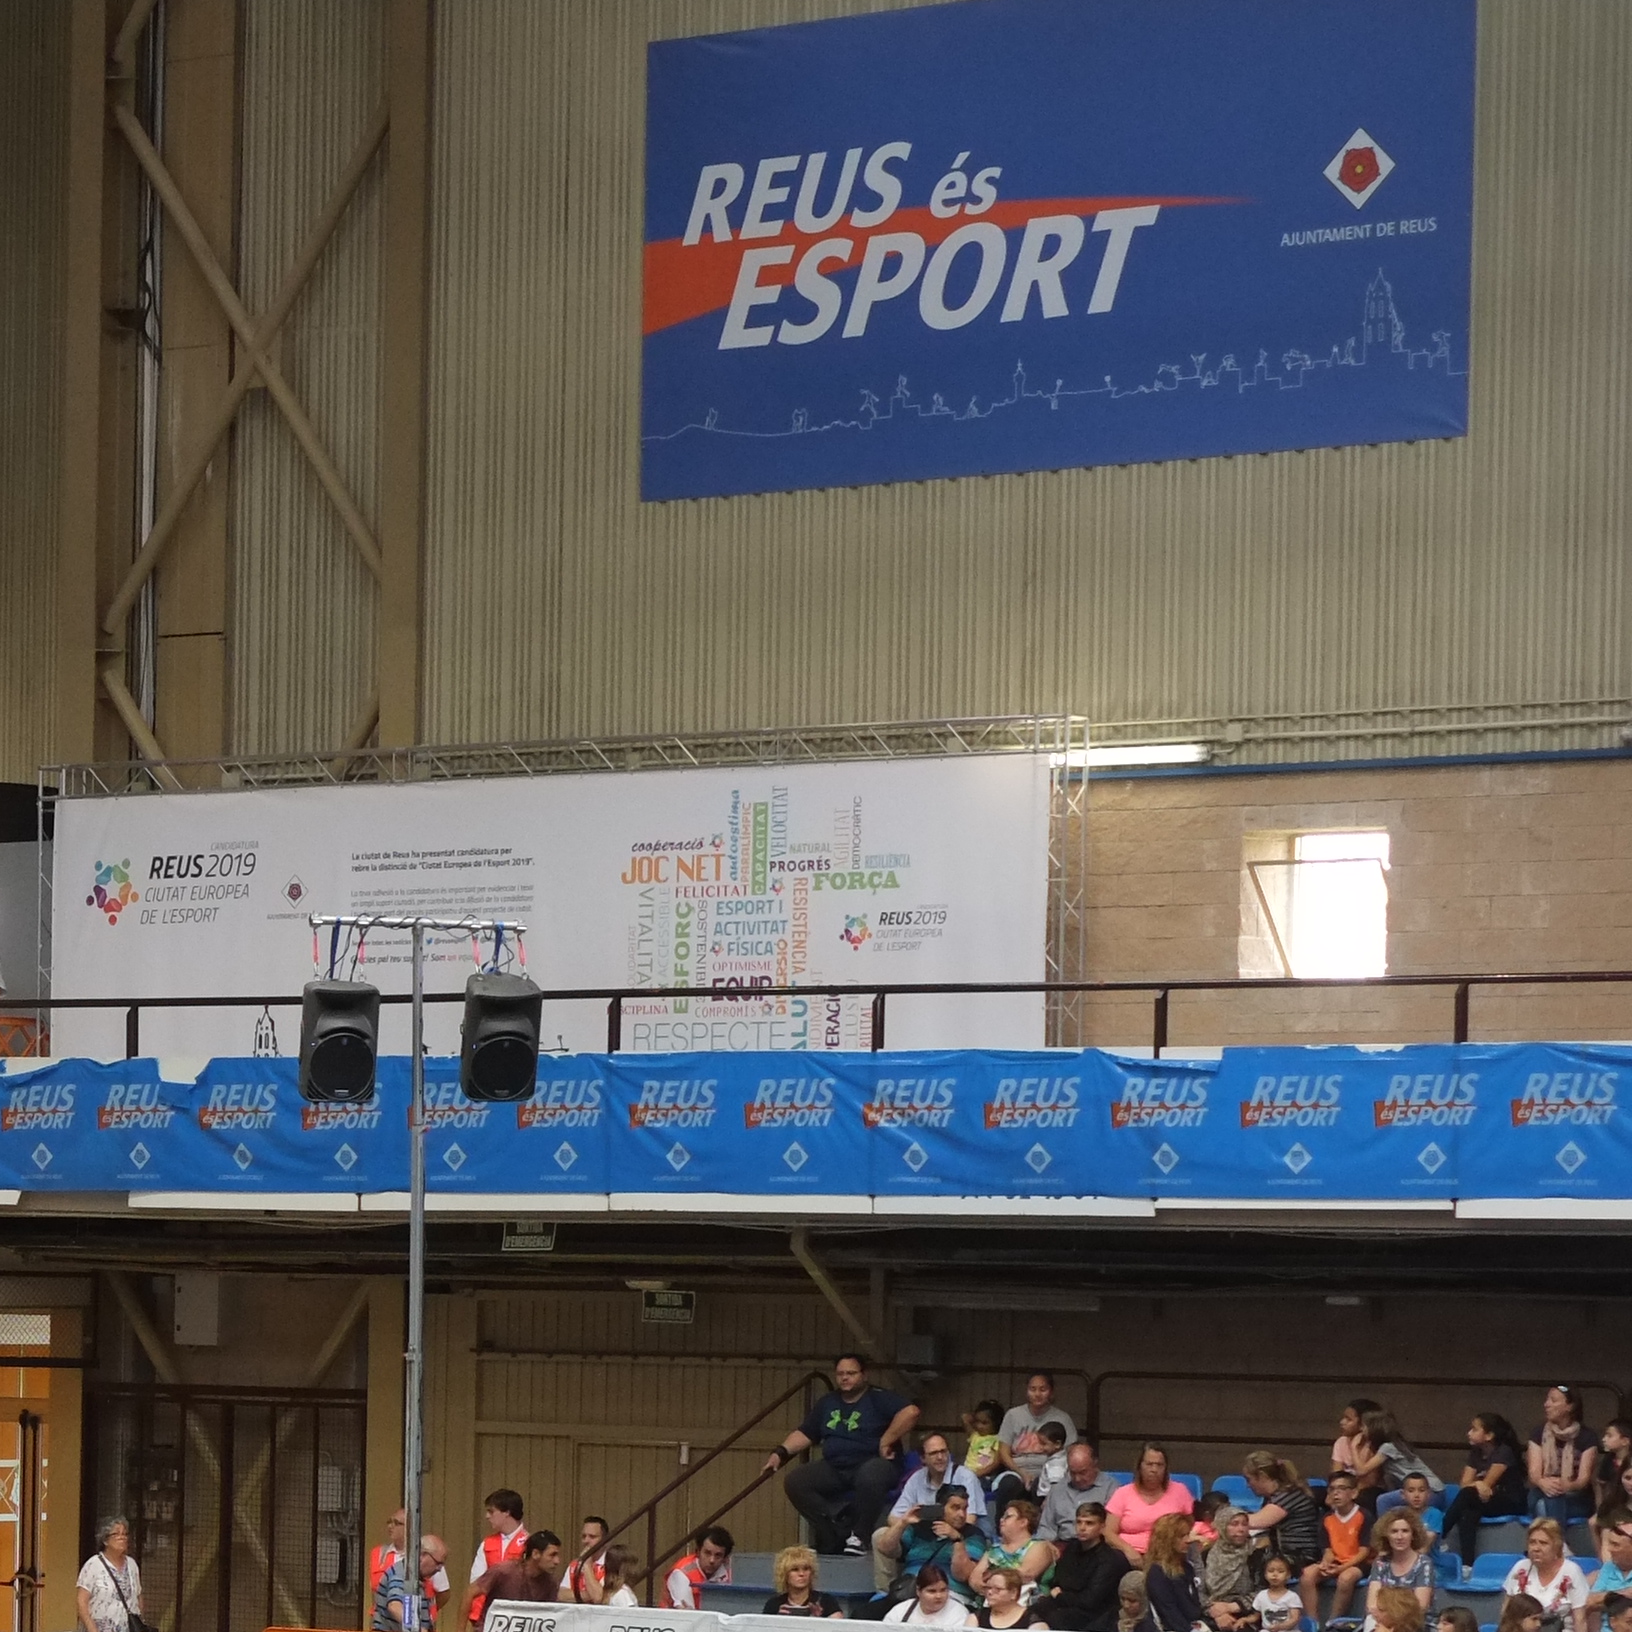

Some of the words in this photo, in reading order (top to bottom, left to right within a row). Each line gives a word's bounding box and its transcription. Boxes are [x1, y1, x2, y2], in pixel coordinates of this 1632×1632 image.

[682, 141, 914, 248] REUS
[929, 151, 1003, 218] és
[1280, 223, 1372, 247] AJUNTAMENT
[1376, 220, 1396, 239] DE
[1399, 216, 1438, 236] REUS
[717, 204, 1162, 351] ESPORT
[727, 789, 741, 881] autoestima
[770, 785, 789, 859] VELOCITAT
[631, 837, 705, 856] cooperació
[754, 803, 768, 894] CAPACITAT
[788, 842, 832, 855] NATURAL
[621, 855, 671, 885] JOC
[676, 853, 725, 883] NET
[769, 855, 832, 873] PROGRÉS
[144, 886, 187, 903] CIUTAT
[190, 883, 250, 902] EUROPEA
[675, 883, 750, 899] FELICITAT
[812, 870, 901, 896] FORÇA
[140, 909, 158, 925] DE
[162, 906, 220, 925] L'ESPORT
[716, 900, 774, 916] ESPORT
[778, 899, 784, 914] I
[637, 886, 655, 989] VITALITA
[713, 920, 788, 937] ACTIVITAT
[791, 876, 811, 976] RESISTÈNCIA
[726, 937, 774, 957] FÍSICA
[712, 960, 774, 974] OPTIMISME
[711, 975, 774, 1004] EQUIP
[632, 1021, 787, 1052] RESPECTE
[9, 1085, 76, 1113] REUS
[207, 1084, 277, 1112] REUS
[753, 1078, 836, 1108] REUS
[993, 1077, 1081, 1108] REUS
[1249, 1074, 1343, 1107] REUS
[1385, 1072, 1480, 1107] REUS
[14, 1110, 75, 1131] ESPORT
[211, 1109, 277, 1130] ESPORT
[760, 1106, 835, 1128] ESPORT
[1000, 1107, 1080, 1128] ESPORT
[1258, 1105, 1342, 1128] ESPORT
[1393, 1104, 1477, 1126] ESPORT
